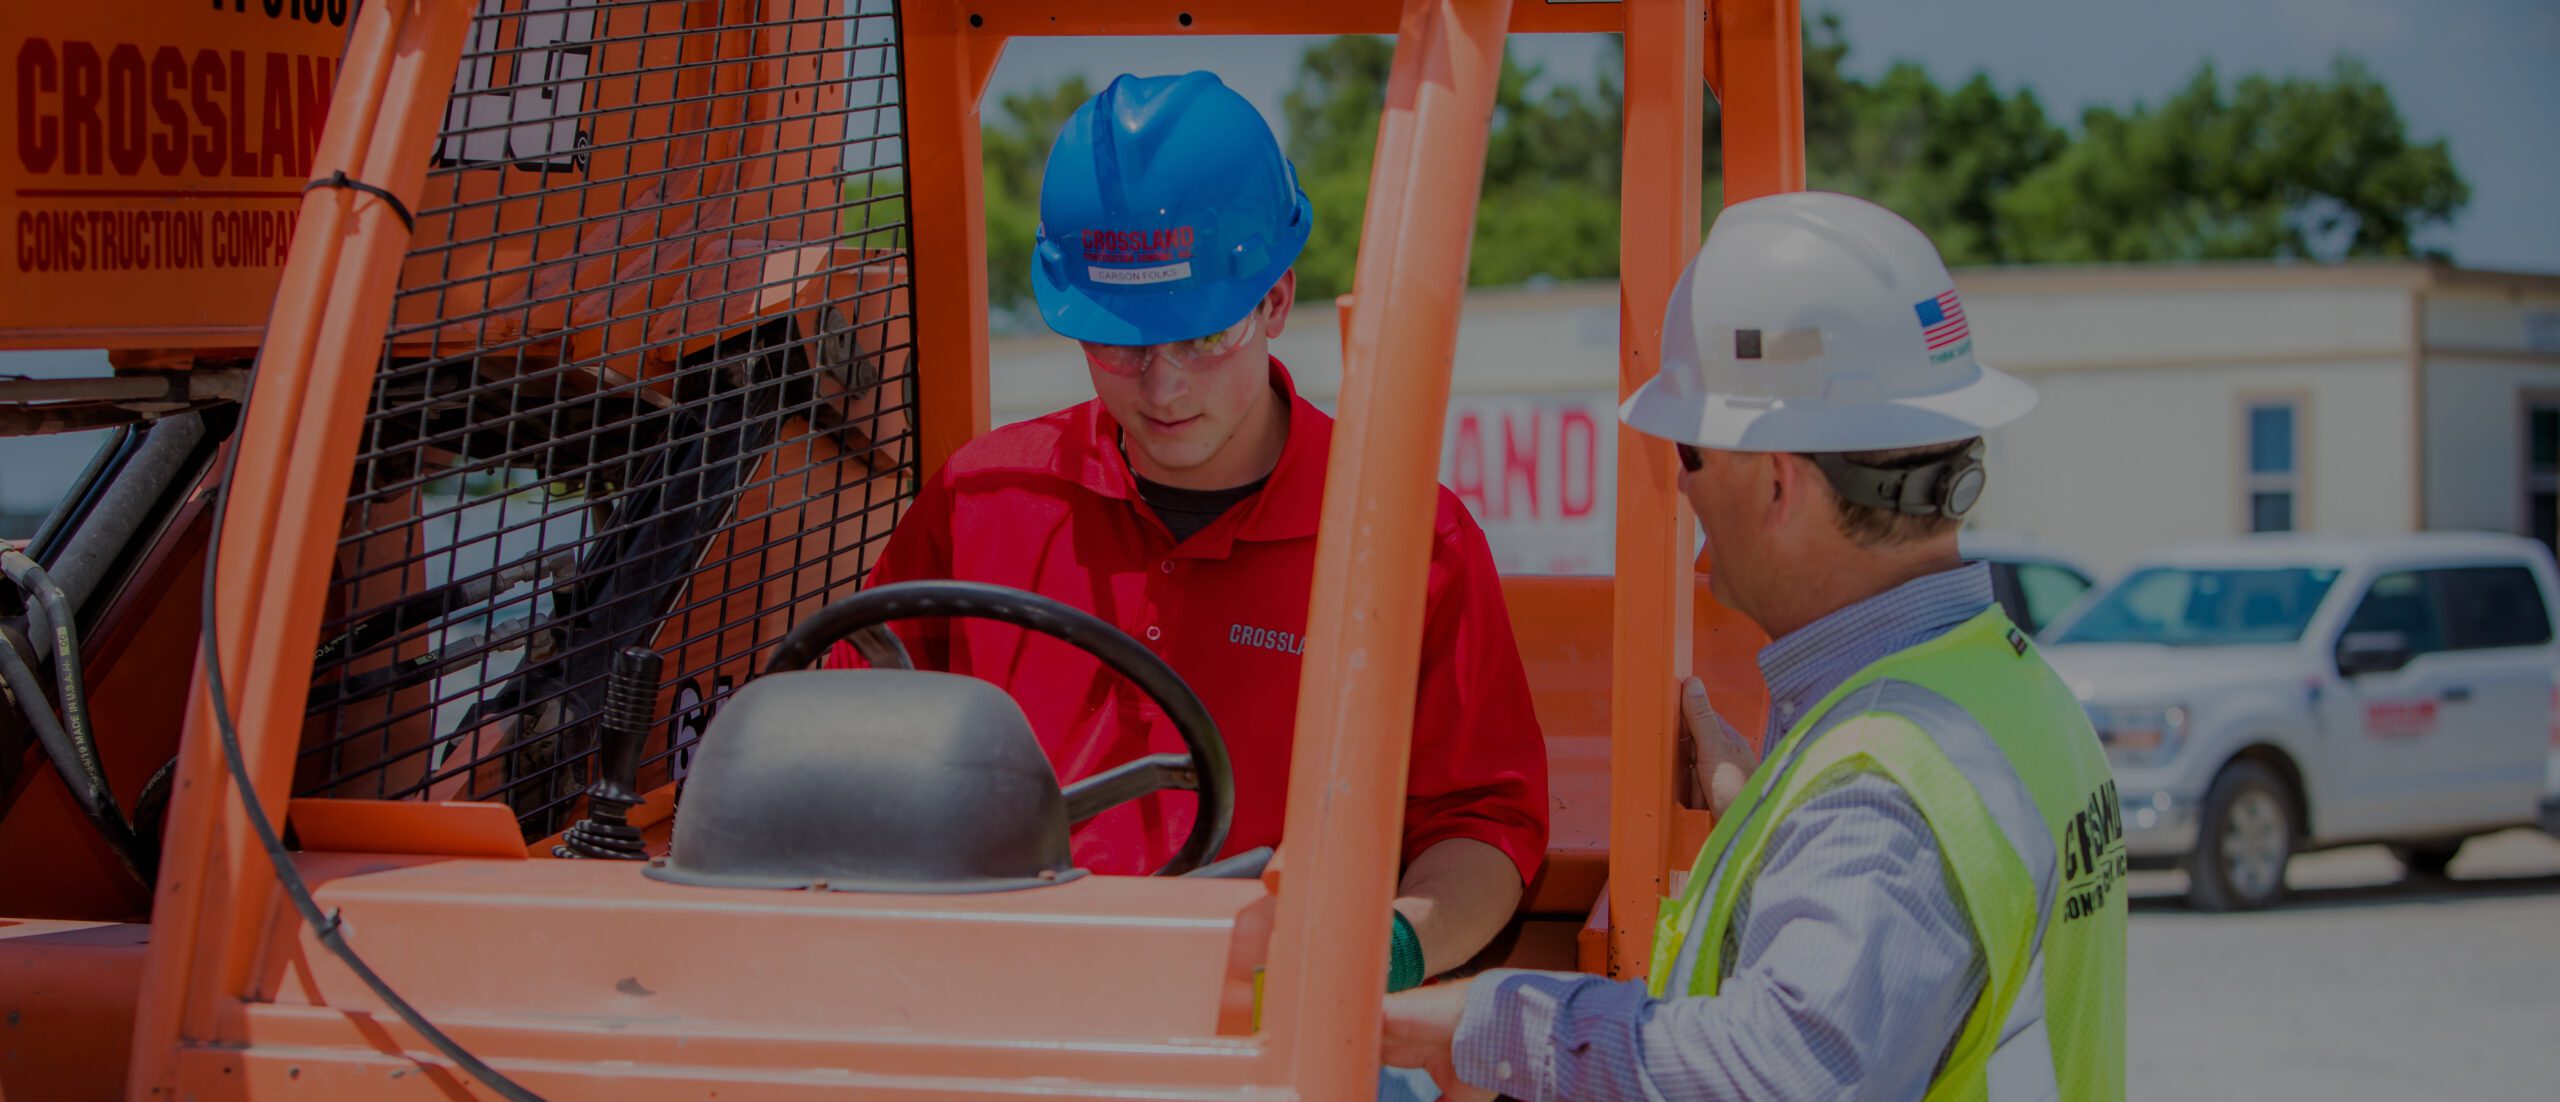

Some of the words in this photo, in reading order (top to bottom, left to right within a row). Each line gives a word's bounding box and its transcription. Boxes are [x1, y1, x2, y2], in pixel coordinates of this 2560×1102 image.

[17, 37, 340, 178] CROSSLAN
[17, 210, 203, 272] CONSTRUCTION
[1081, 225, 1195, 252] CROSSLAND
[1098, 270, 1140, 282] CARSON
[1143, 268, 1178, 280] FOLKS
[1453, 408, 1598, 518] AND
[1228, 623, 1307, 656] CROSSLA
[67, 701, 78, 713] IN
[71, 714, 85, 745] MADE
